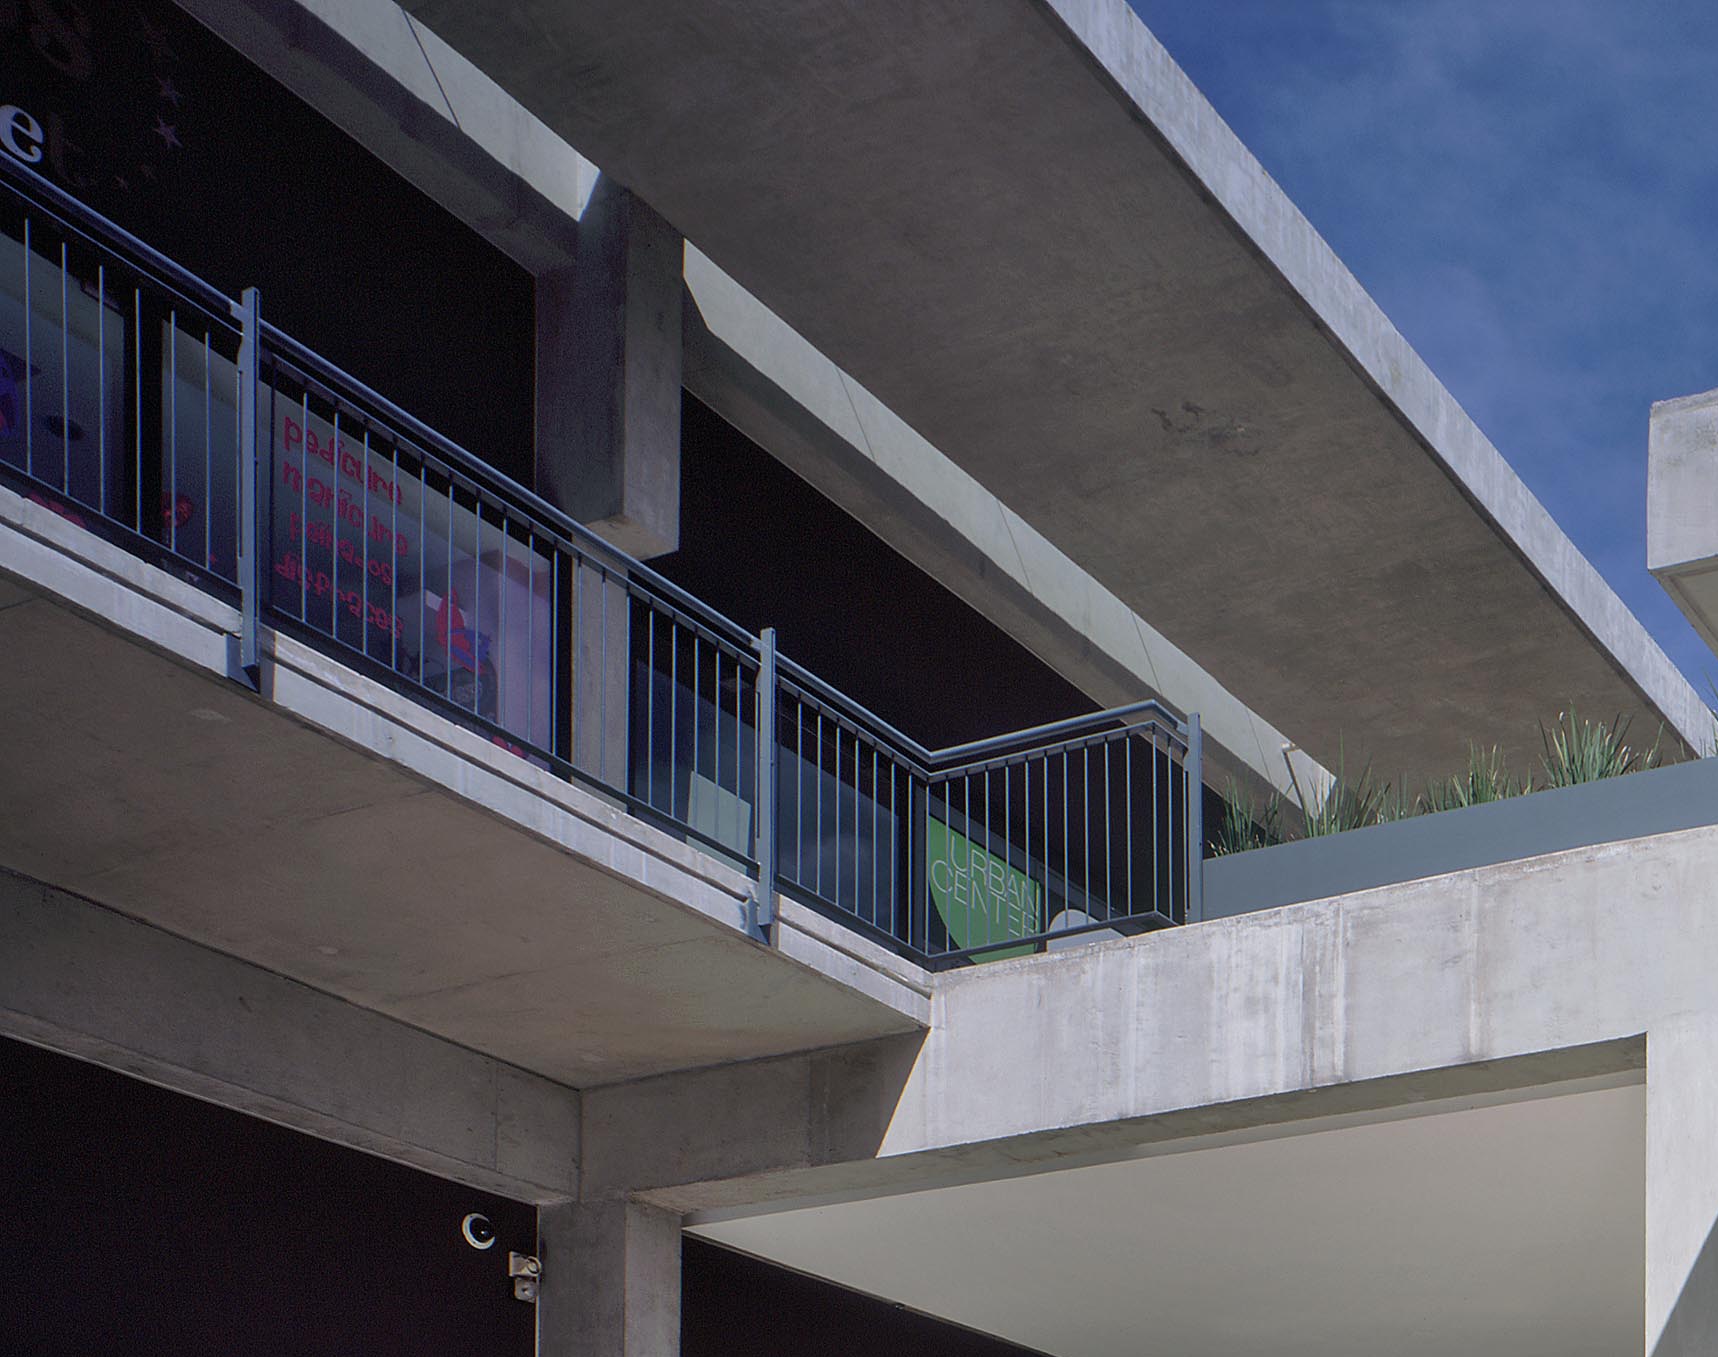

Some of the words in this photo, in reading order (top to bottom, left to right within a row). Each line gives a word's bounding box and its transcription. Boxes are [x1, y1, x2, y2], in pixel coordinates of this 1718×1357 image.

[283, 415, 403, 506] pedicure
[282, 461, 409, 558] manicure
[931, 860, 1038, 938] CENTER
[950, 835, 1040, 919] URBAN
